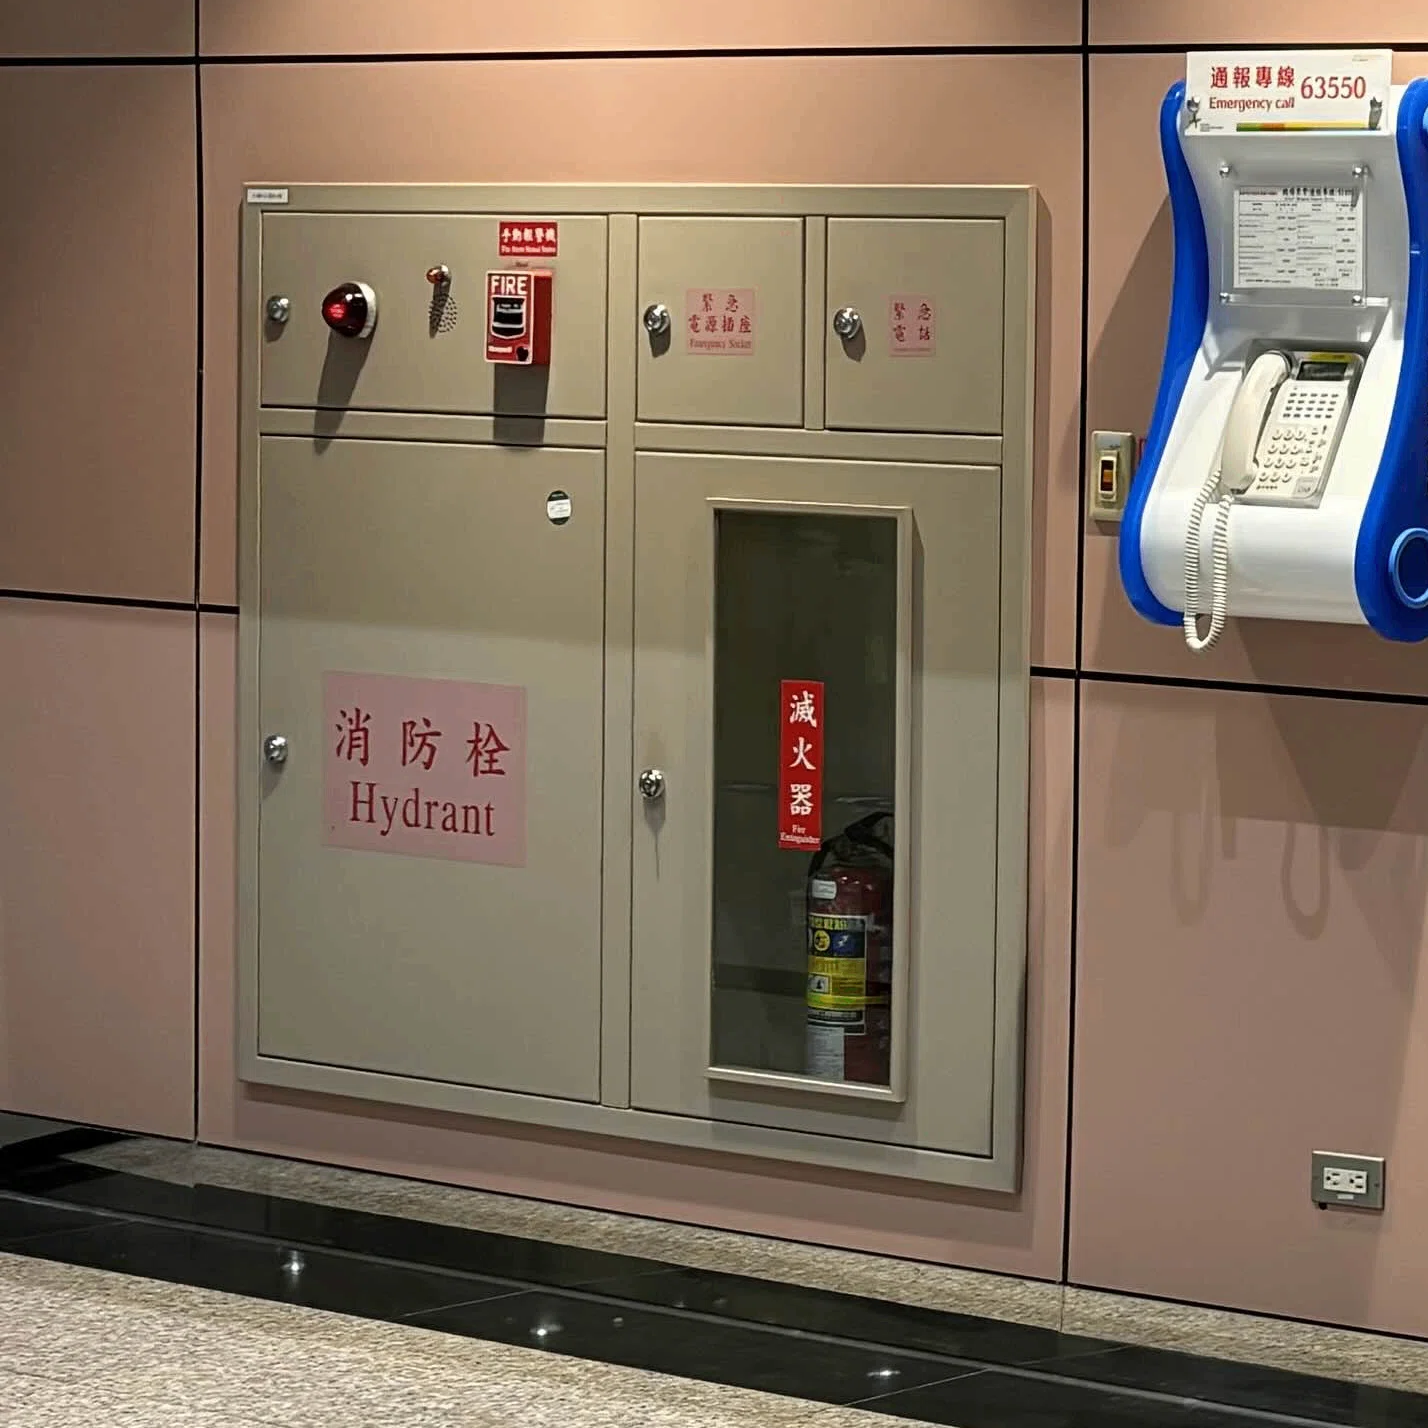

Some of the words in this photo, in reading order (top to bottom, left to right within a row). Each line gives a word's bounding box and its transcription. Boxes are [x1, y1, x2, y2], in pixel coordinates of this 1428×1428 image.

[1210, 66, 1295, 90] 通報專線
[1300, 75, 1367, 100] 63550
[1209, 96, 1272, 113] Emergency
[1275, 96, 1295, 110] call
[490, 275, 529, 295] FIRE
[702, 292, 739, 313] 緊急
[335, 707, 511, 777] 消防栓
[350, 780, 496, 837] Hydrant
